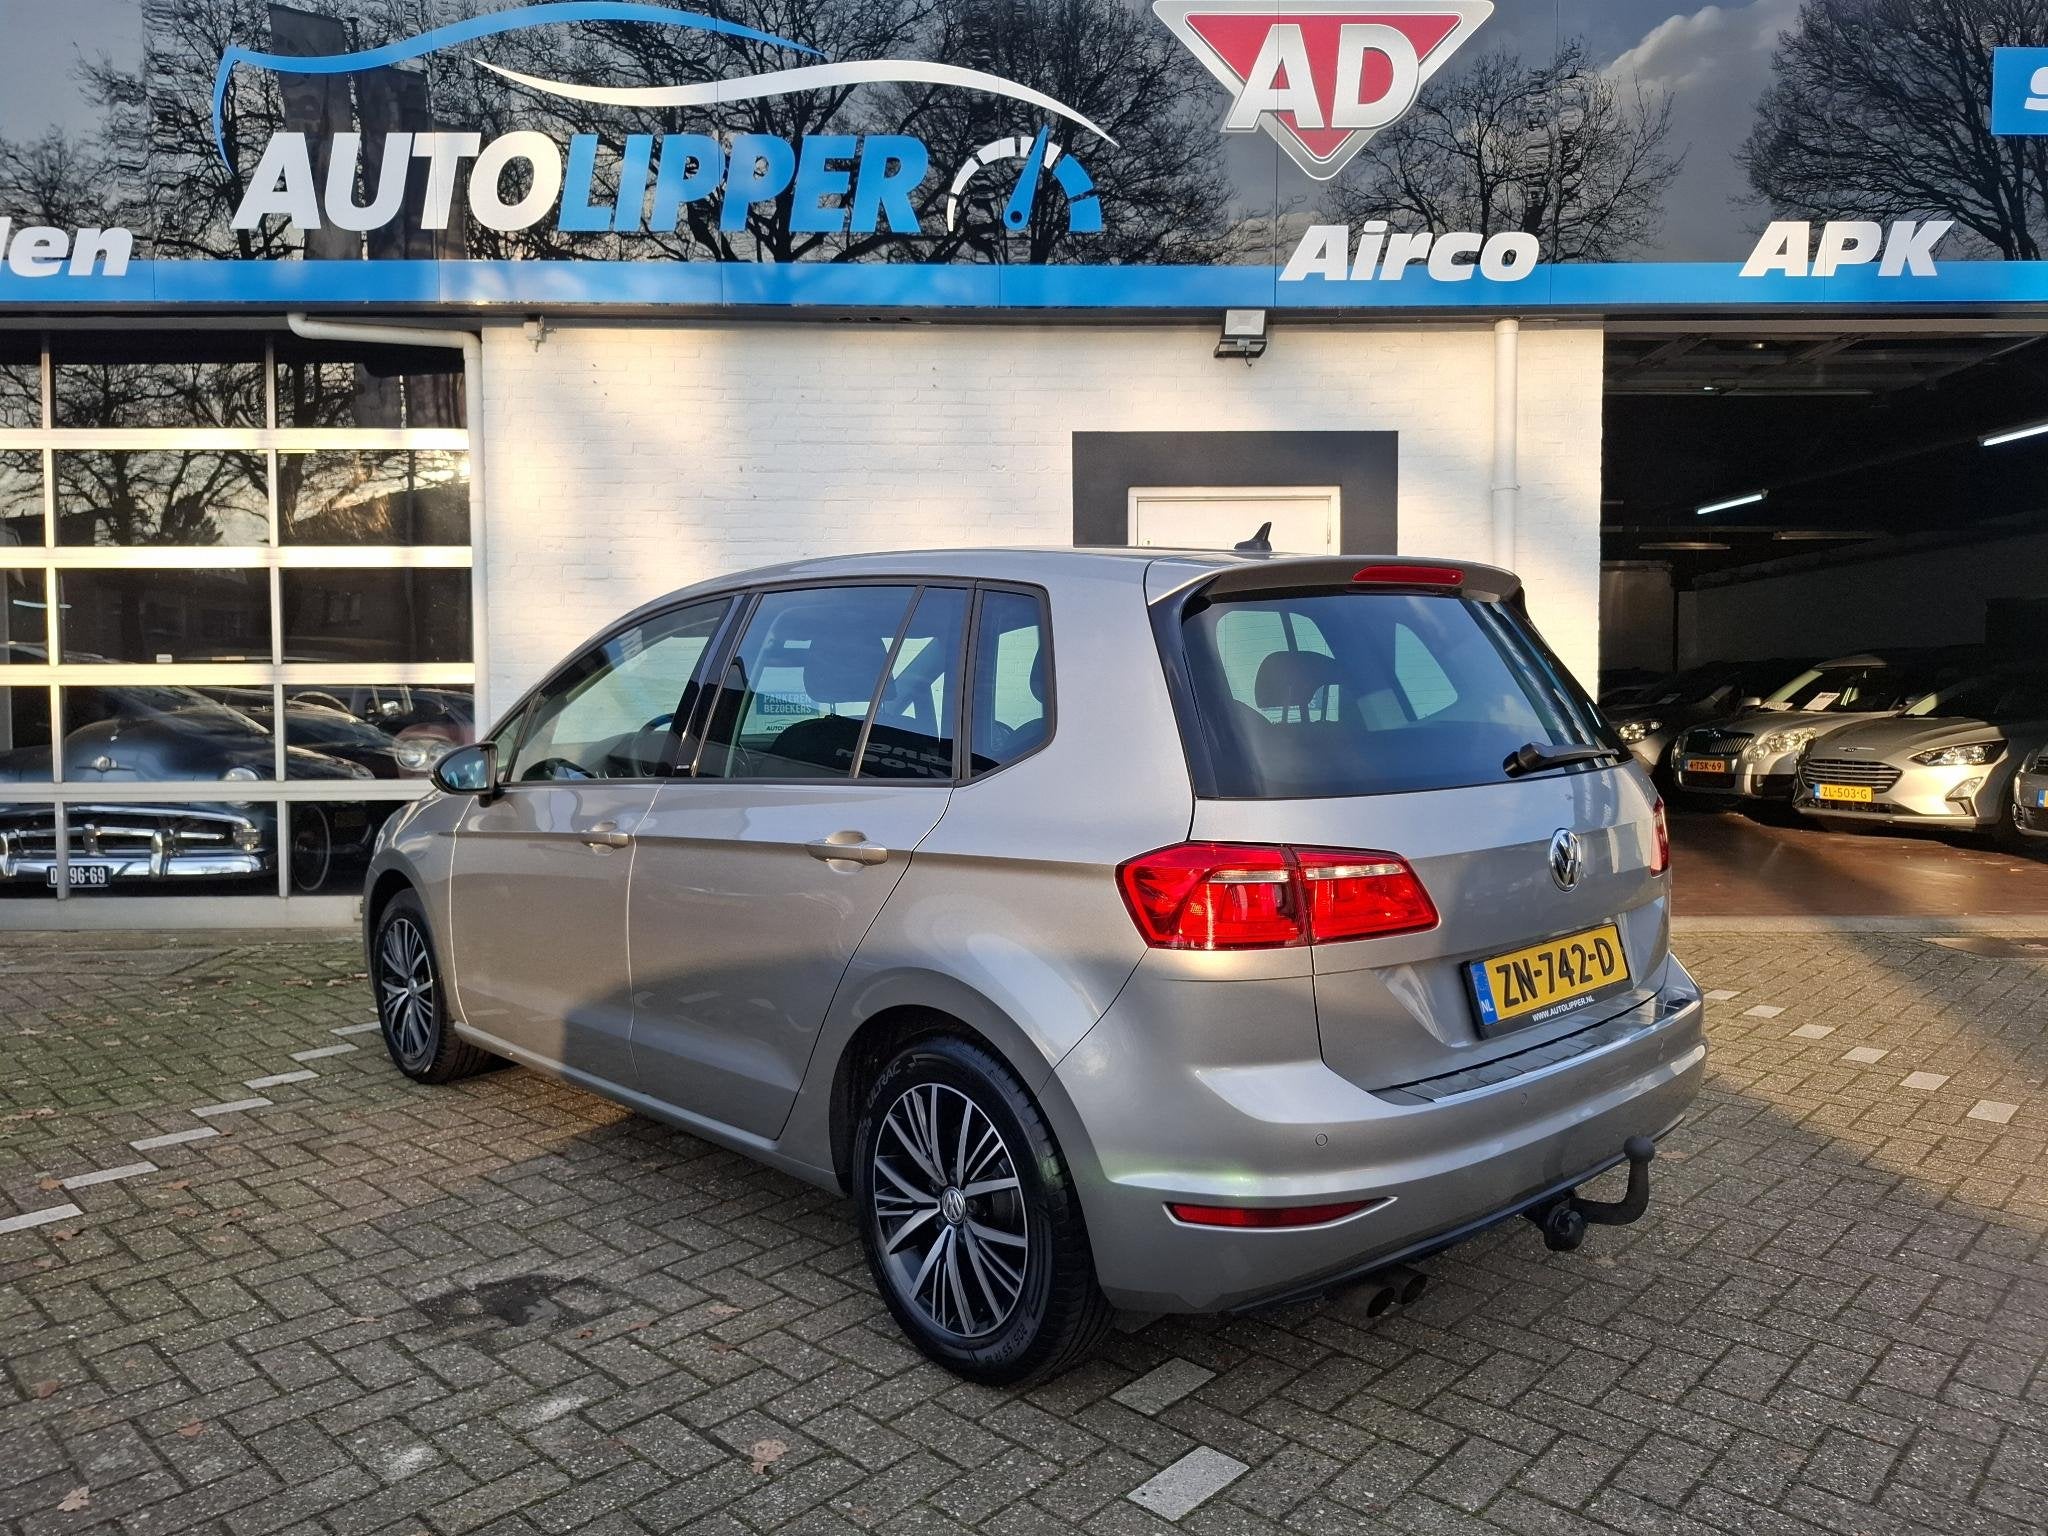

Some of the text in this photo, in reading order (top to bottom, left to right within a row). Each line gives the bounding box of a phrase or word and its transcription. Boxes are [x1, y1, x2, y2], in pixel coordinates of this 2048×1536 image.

[1224, 23, 1420, 130] AD
[231, 129, 929, 233] AUTOLIPPER
[1278, 220, 1540, 282] Airco
[1739, 220, 1955, 277] APK
[764, 693, 812, 703] PARKEREN
[764, 704, 812, 714] BEZOEKERS
[1822, 785, 1868, 800] ZL-503-G
[1480, 937, 1615, 1014] NL ZN-742-D
[1532, 994, 1595, 1022] WWW.AUTOLIPPER.NL
